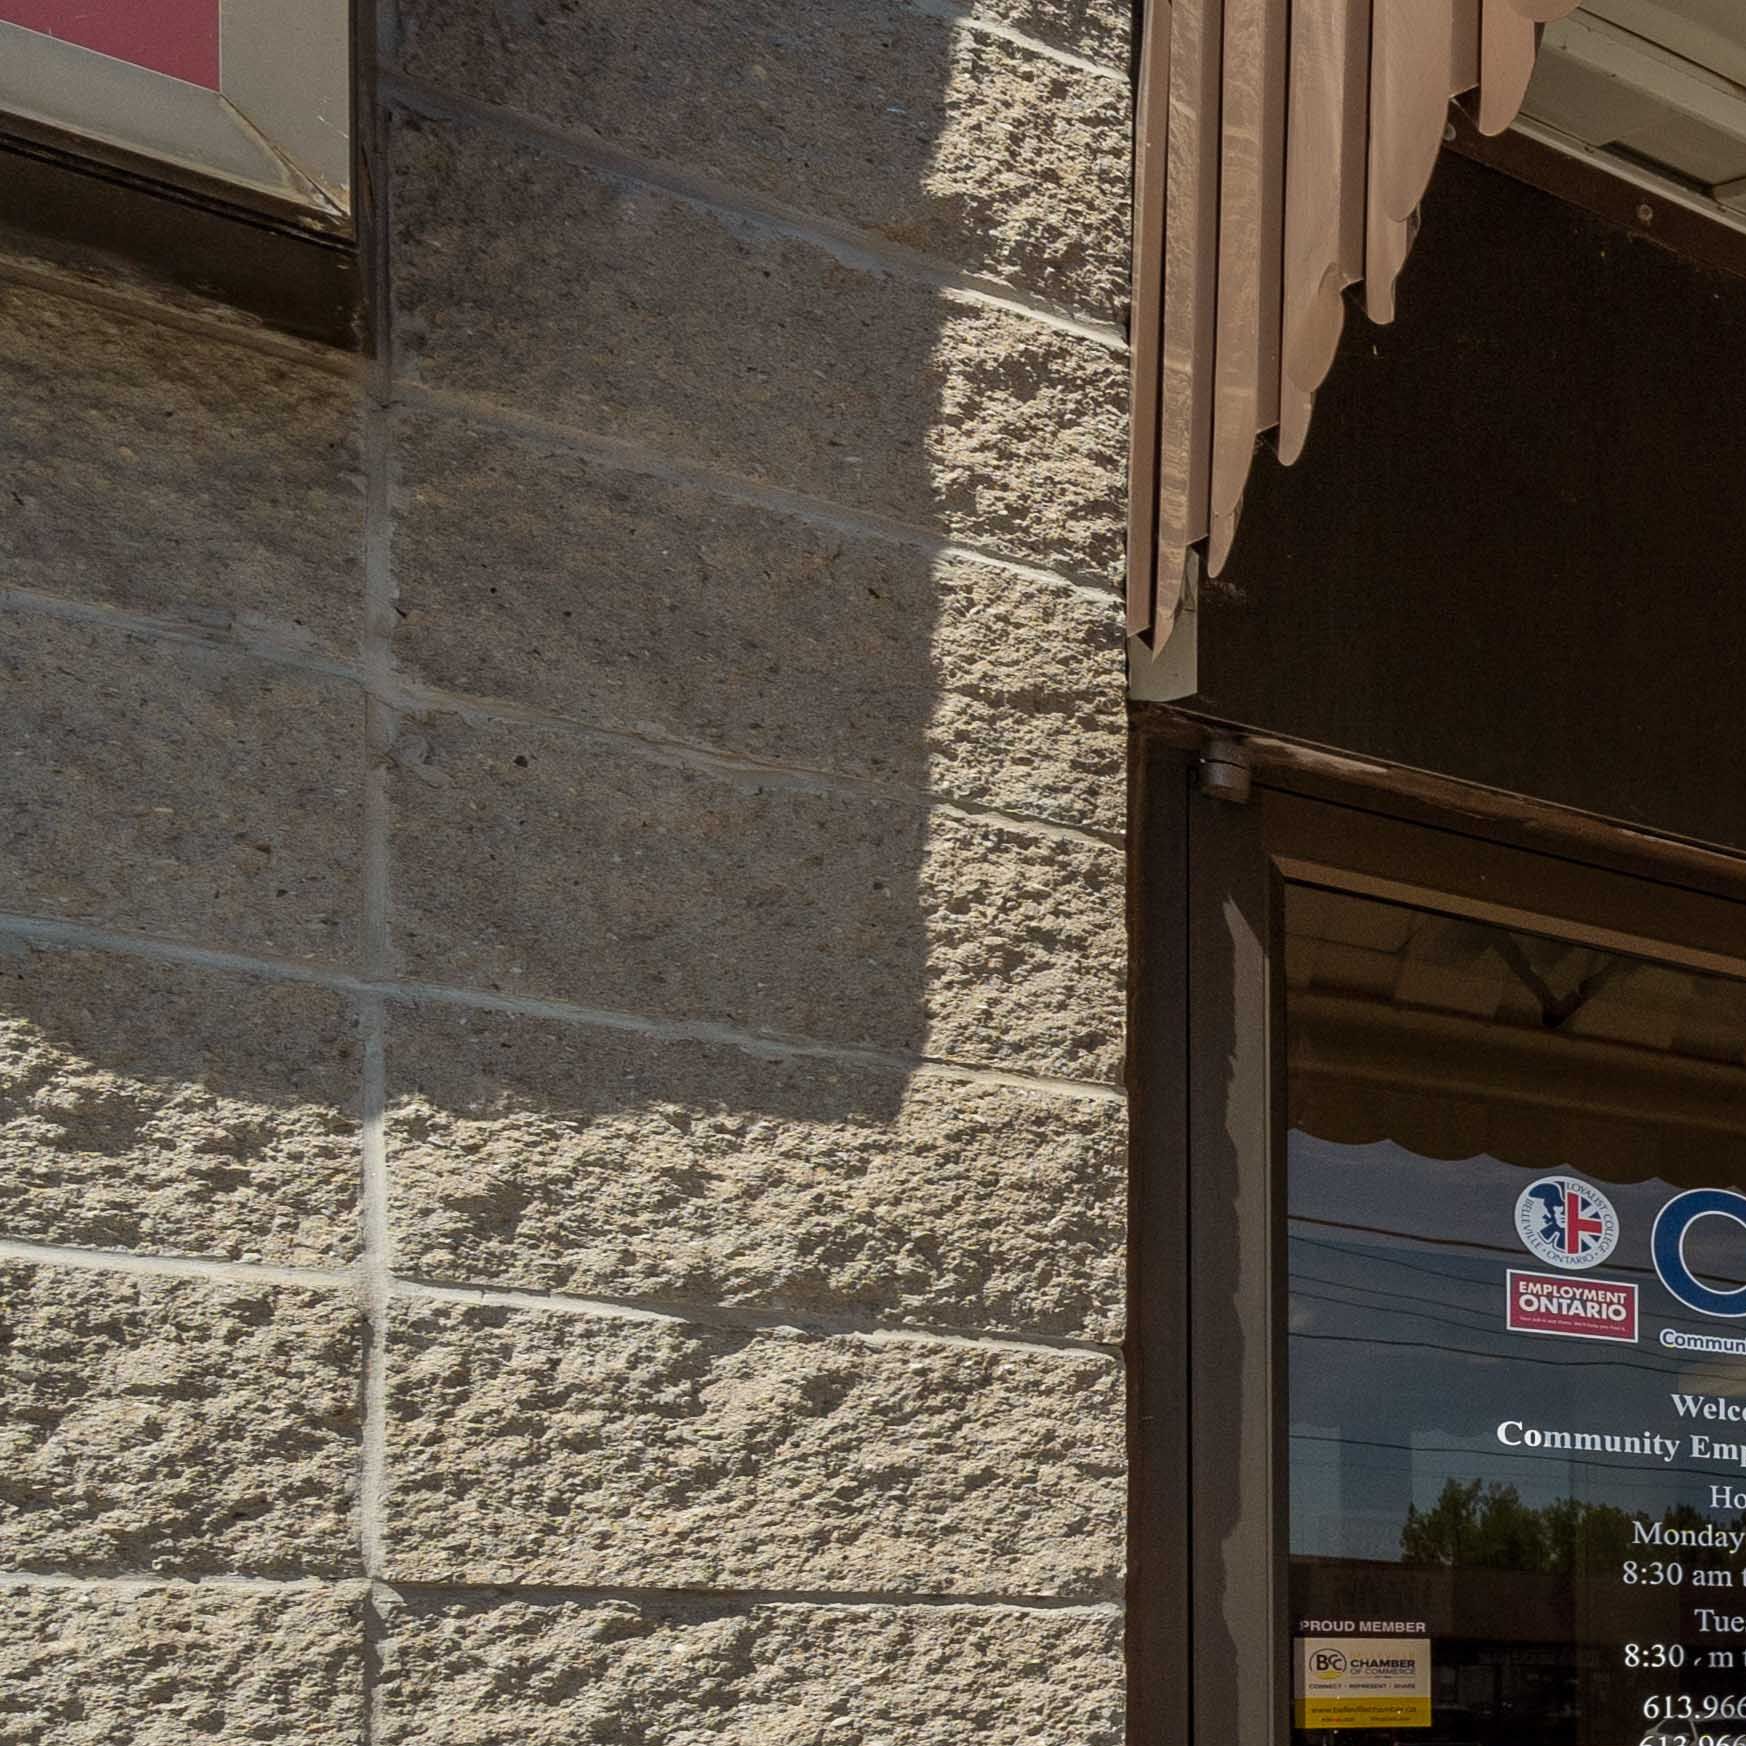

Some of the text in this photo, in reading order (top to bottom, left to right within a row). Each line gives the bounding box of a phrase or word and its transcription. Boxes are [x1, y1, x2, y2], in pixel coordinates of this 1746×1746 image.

[1566, 1182, 1615, 1254] LOYALIST COLLEGE
[1546, 1250, 1595, 1265] ONTARIO
[1518, 1281, 1627, 1305] EMPLOYMENT
[1518, 1294, 1627, 1322] ONTARIO
[1496, 1420, 1680, 1462] Community
[1631, 1520, 1745, 1554] Monday
[1622, 1561, 1683, 1585] 8:30
[1691, 1568, 1735, 1588] am
[1300, 1620, 1427, 1633] PROUD MEMBER
[1350, 1659, 1416, 1668] CHAMBER
[1624, 1643, 1684, 1668] 8:30
